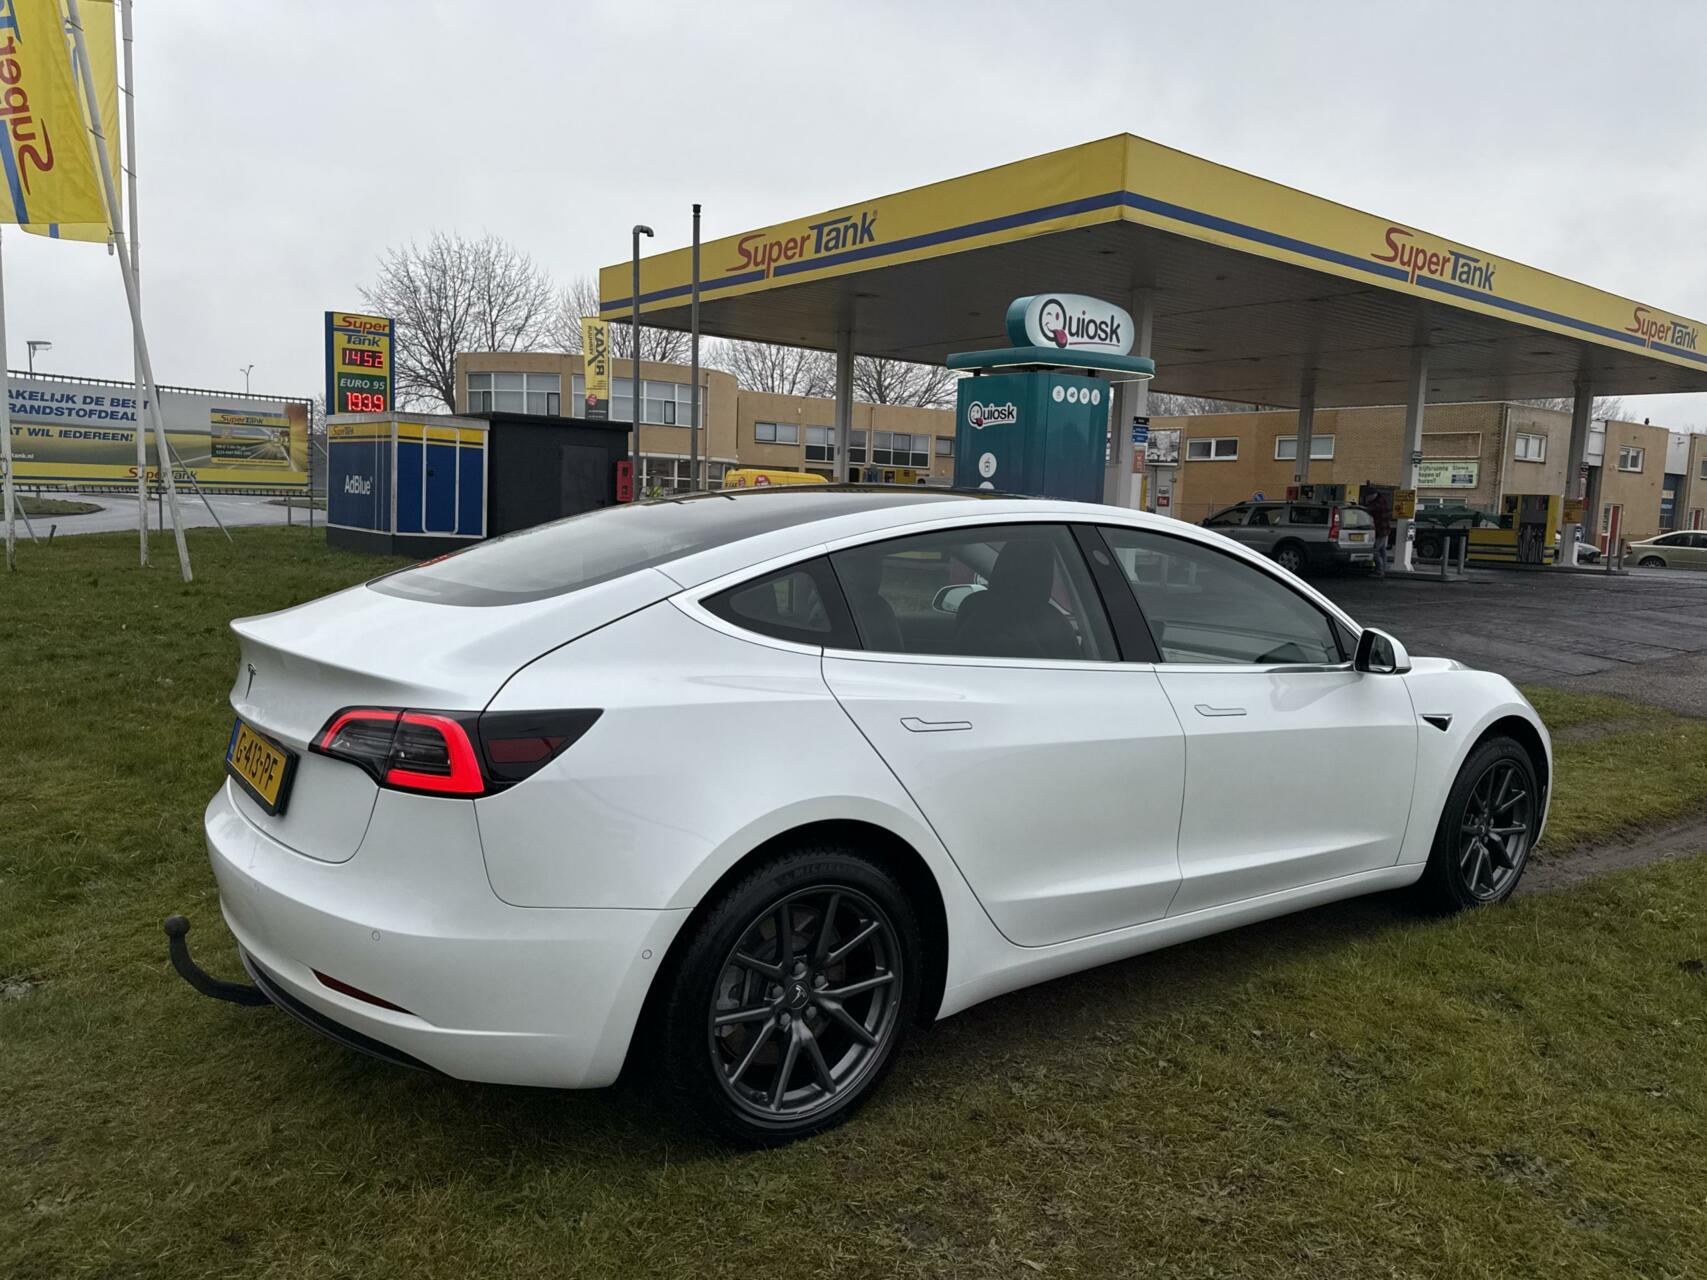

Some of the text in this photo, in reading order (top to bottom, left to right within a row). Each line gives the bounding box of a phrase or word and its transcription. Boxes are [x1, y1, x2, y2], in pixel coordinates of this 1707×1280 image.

[725, 212, 878, 279] SuperTank
[1370, 226, 1496, 291] SuperTank
[335, 316, 389, 334] Super
[1039, 298, 1121, 345] Quiosk
[1623, 306, 1699, 350] SuperTank
[343, 333, 381, 347] Tank
[340, 378, 386, 390] EURO 95
[82, 395, 106, 406] DE
[9, 402, 137, 422] RANDSTOFDEAL
[969, 402, 1015, 425] Quiosk
[27, 427, 54, 438] WIL
[58, 429, 133, 442] IEDEREEN!
